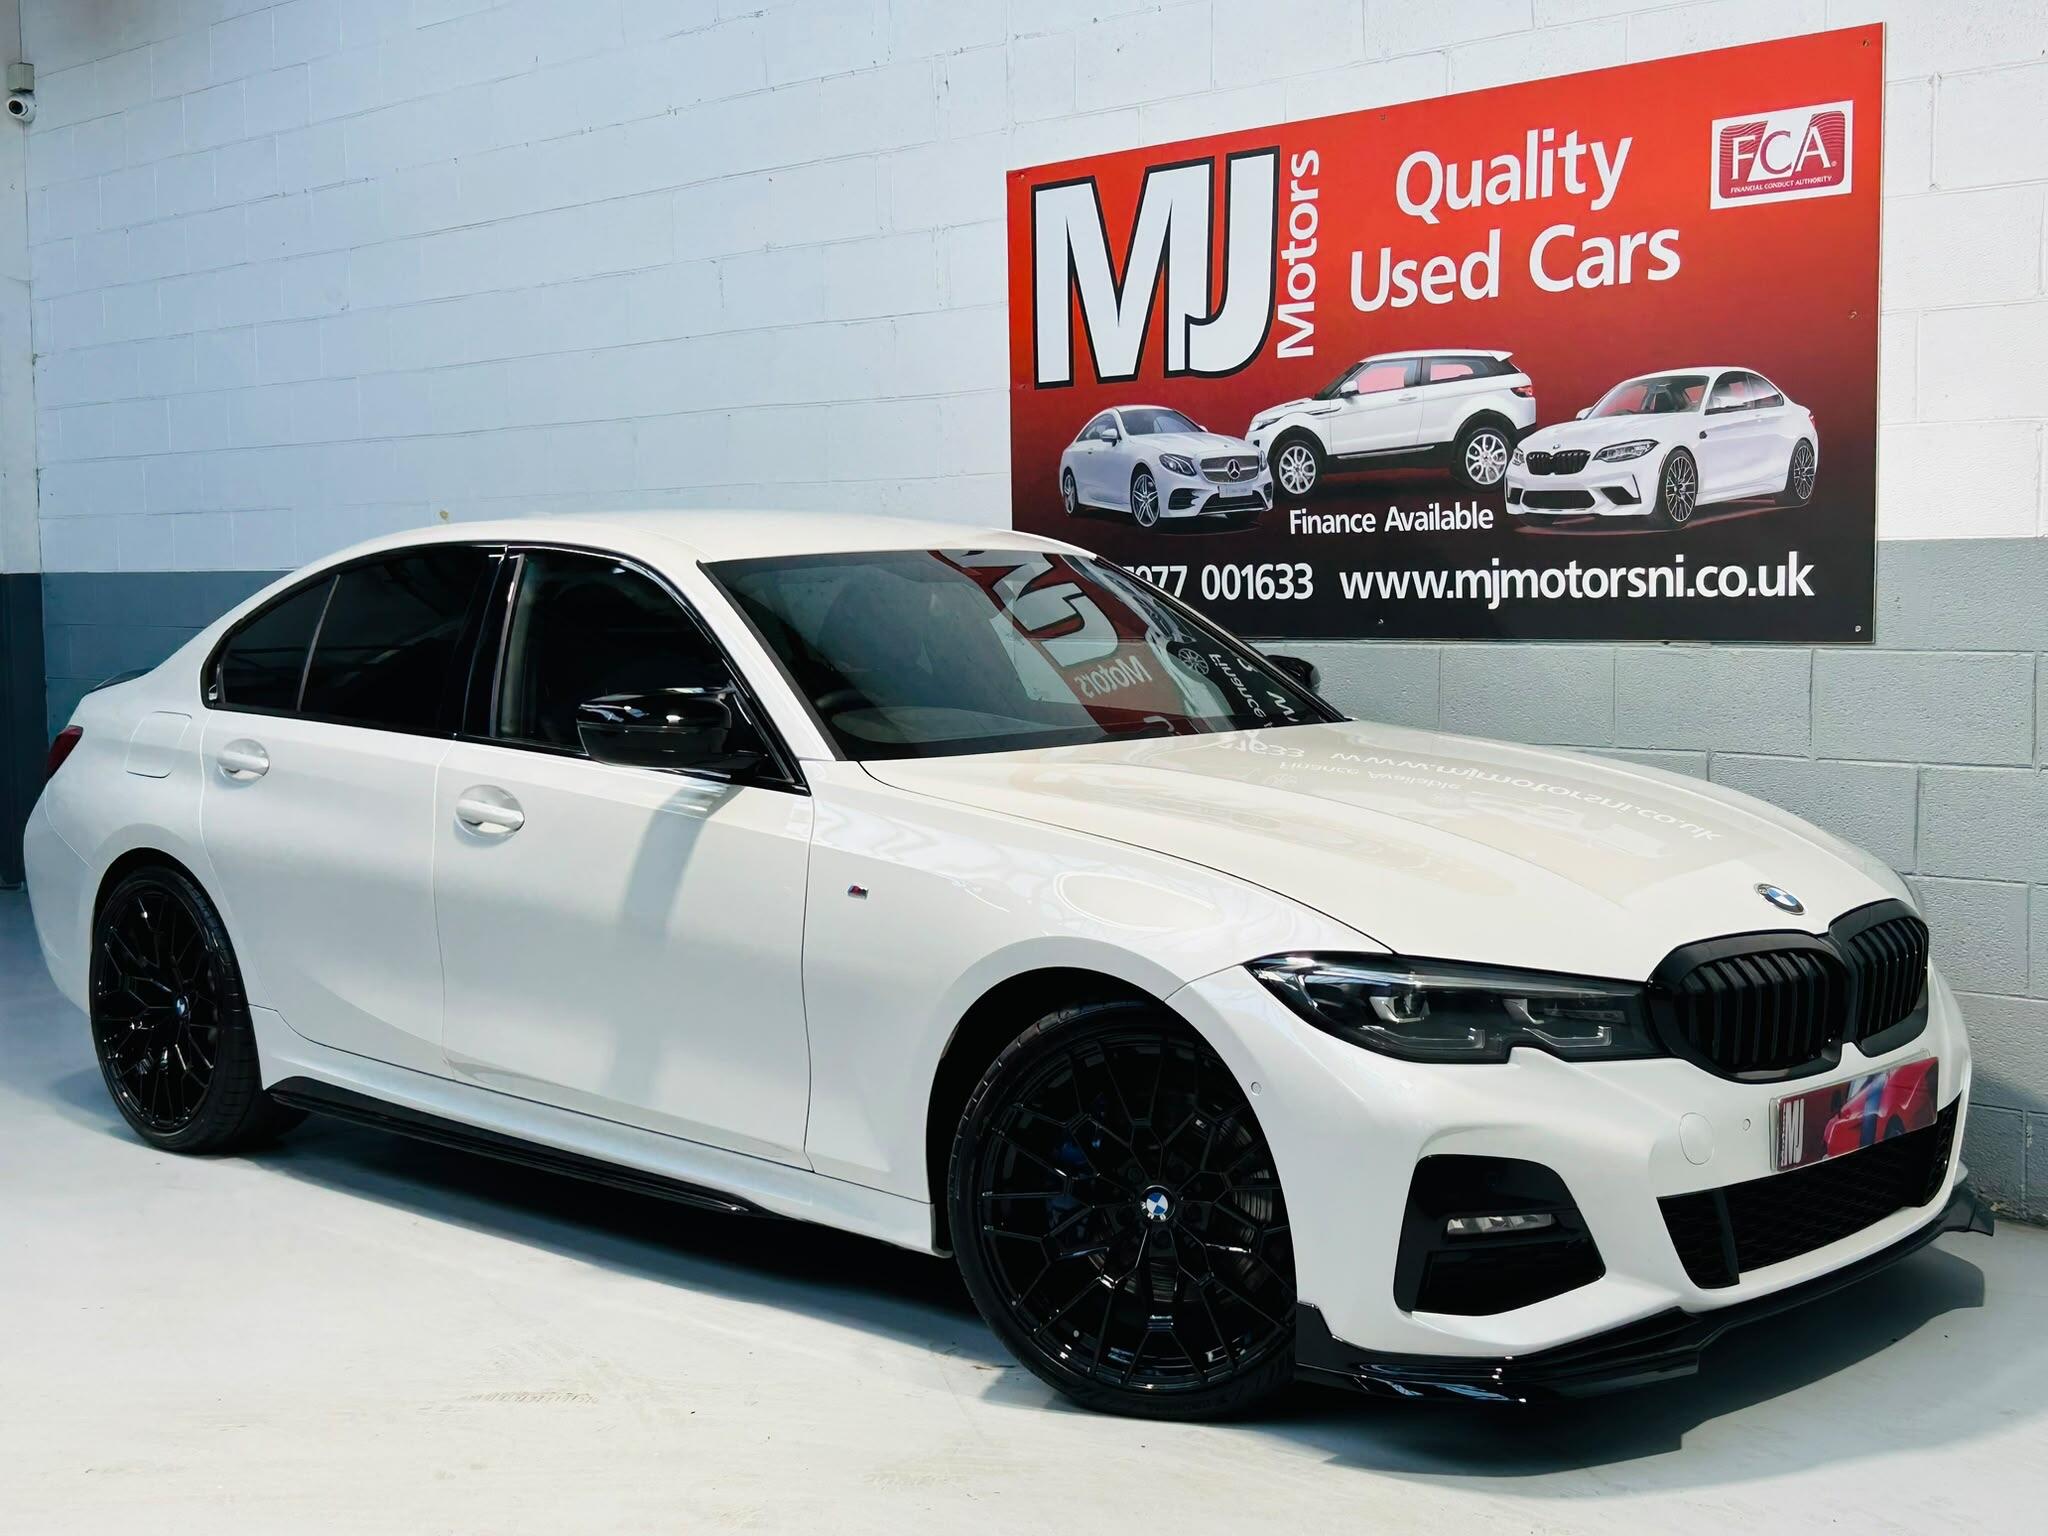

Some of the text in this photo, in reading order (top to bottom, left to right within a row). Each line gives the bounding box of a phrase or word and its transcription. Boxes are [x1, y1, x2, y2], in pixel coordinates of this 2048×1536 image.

[1395, 127, 1633, 224] Quality
[1731, 126, 1832, 180] FCA
[1730, 176, 1832, 193] FINANCIAL CONDUCT AUTHORITY
[1032, 146, 1280, 389] MJ
[1277, 149, 1320, 358] Motors
[1350, 224, 1681, 312] Used Cars
[1289, 502, 1493, 535] Finance Available
[1201, 563, 1314, 600] 001633
[1339, 551, 1815, 609] www.mjmotorsni.co.uk
